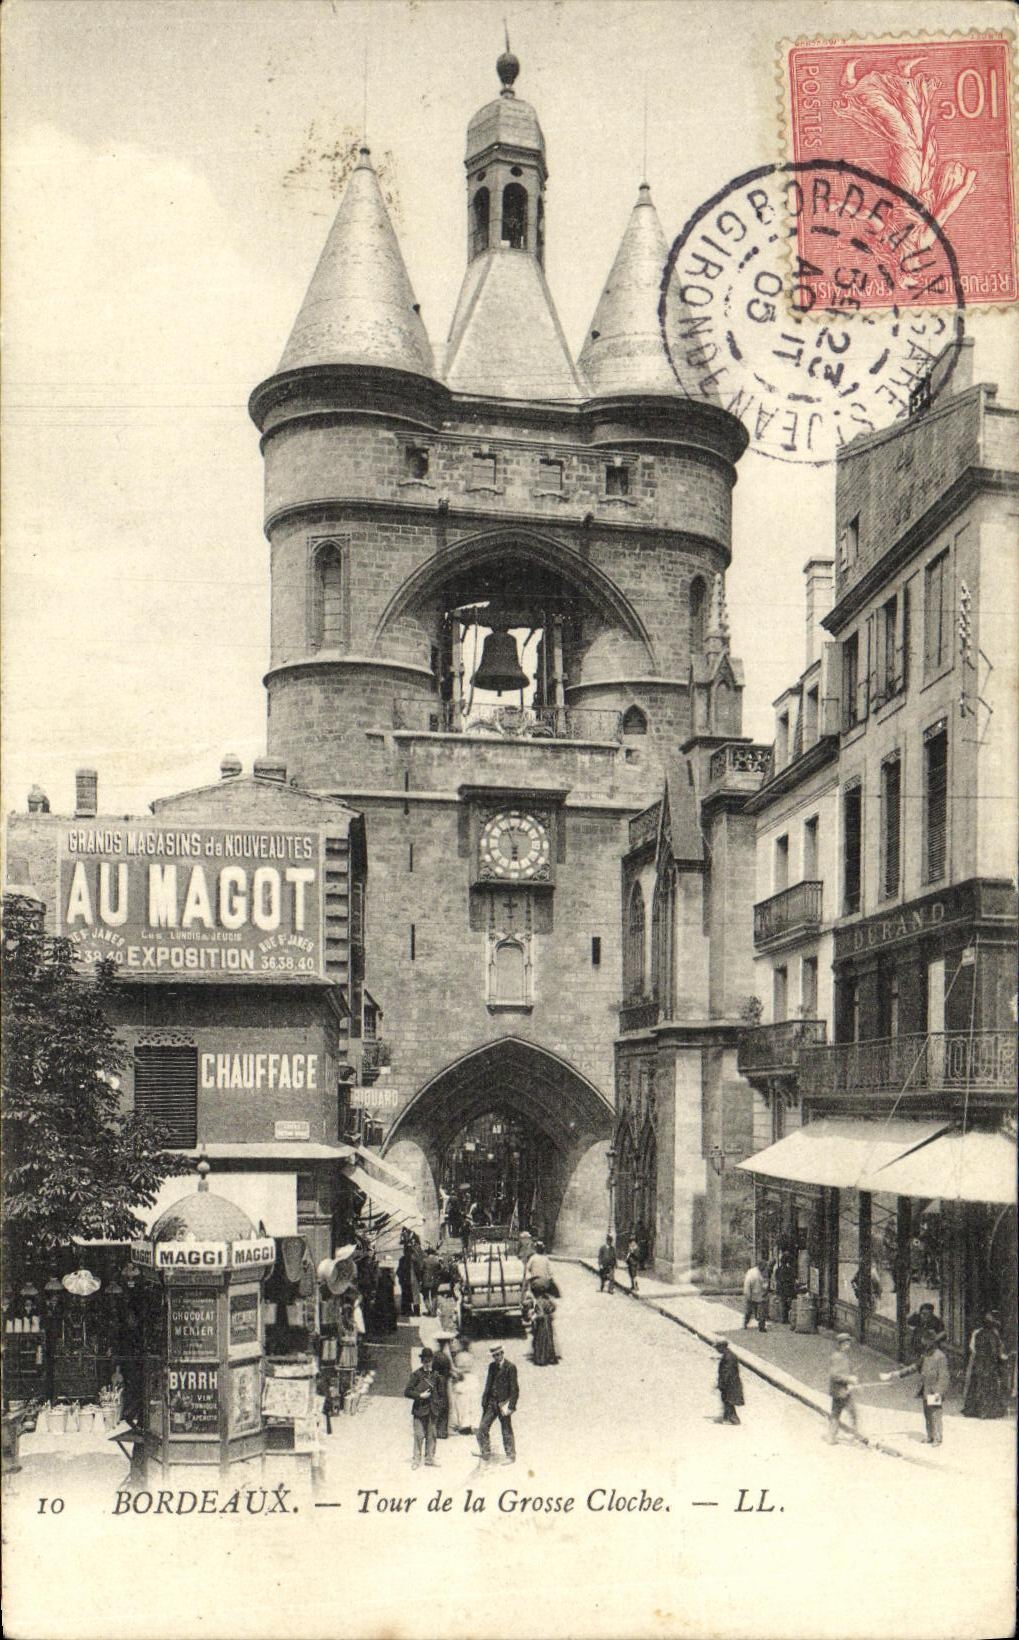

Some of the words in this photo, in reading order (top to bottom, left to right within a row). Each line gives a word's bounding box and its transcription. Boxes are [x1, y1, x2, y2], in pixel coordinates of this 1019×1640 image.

[68, 829, 122, 854] GRANDS
[127, 831, 201, 857] MAGASINS
[205, 836, 222, 856] de
[66, 861, 128, 927] AU
[148, 863, 315, 931] MAGOT
[854, 902, 945, 949] DURAND
[91, 927, 126, 947] JAMES
[258, 936, 277, 953] RUE
[287, 935, 314, 953] JAMES
[127, 946, 254, 969] EXPOSITION
[201, 1053, 318, 1089] CHAUFFAGE
[160, 1250, 222, 1265] MAGGI
[234, 1246, 274, 1263] MAGGI
[172, 1311, 215, 1321] CHOCOLAT
[169, 1371, 218, 1390] BYRRH
